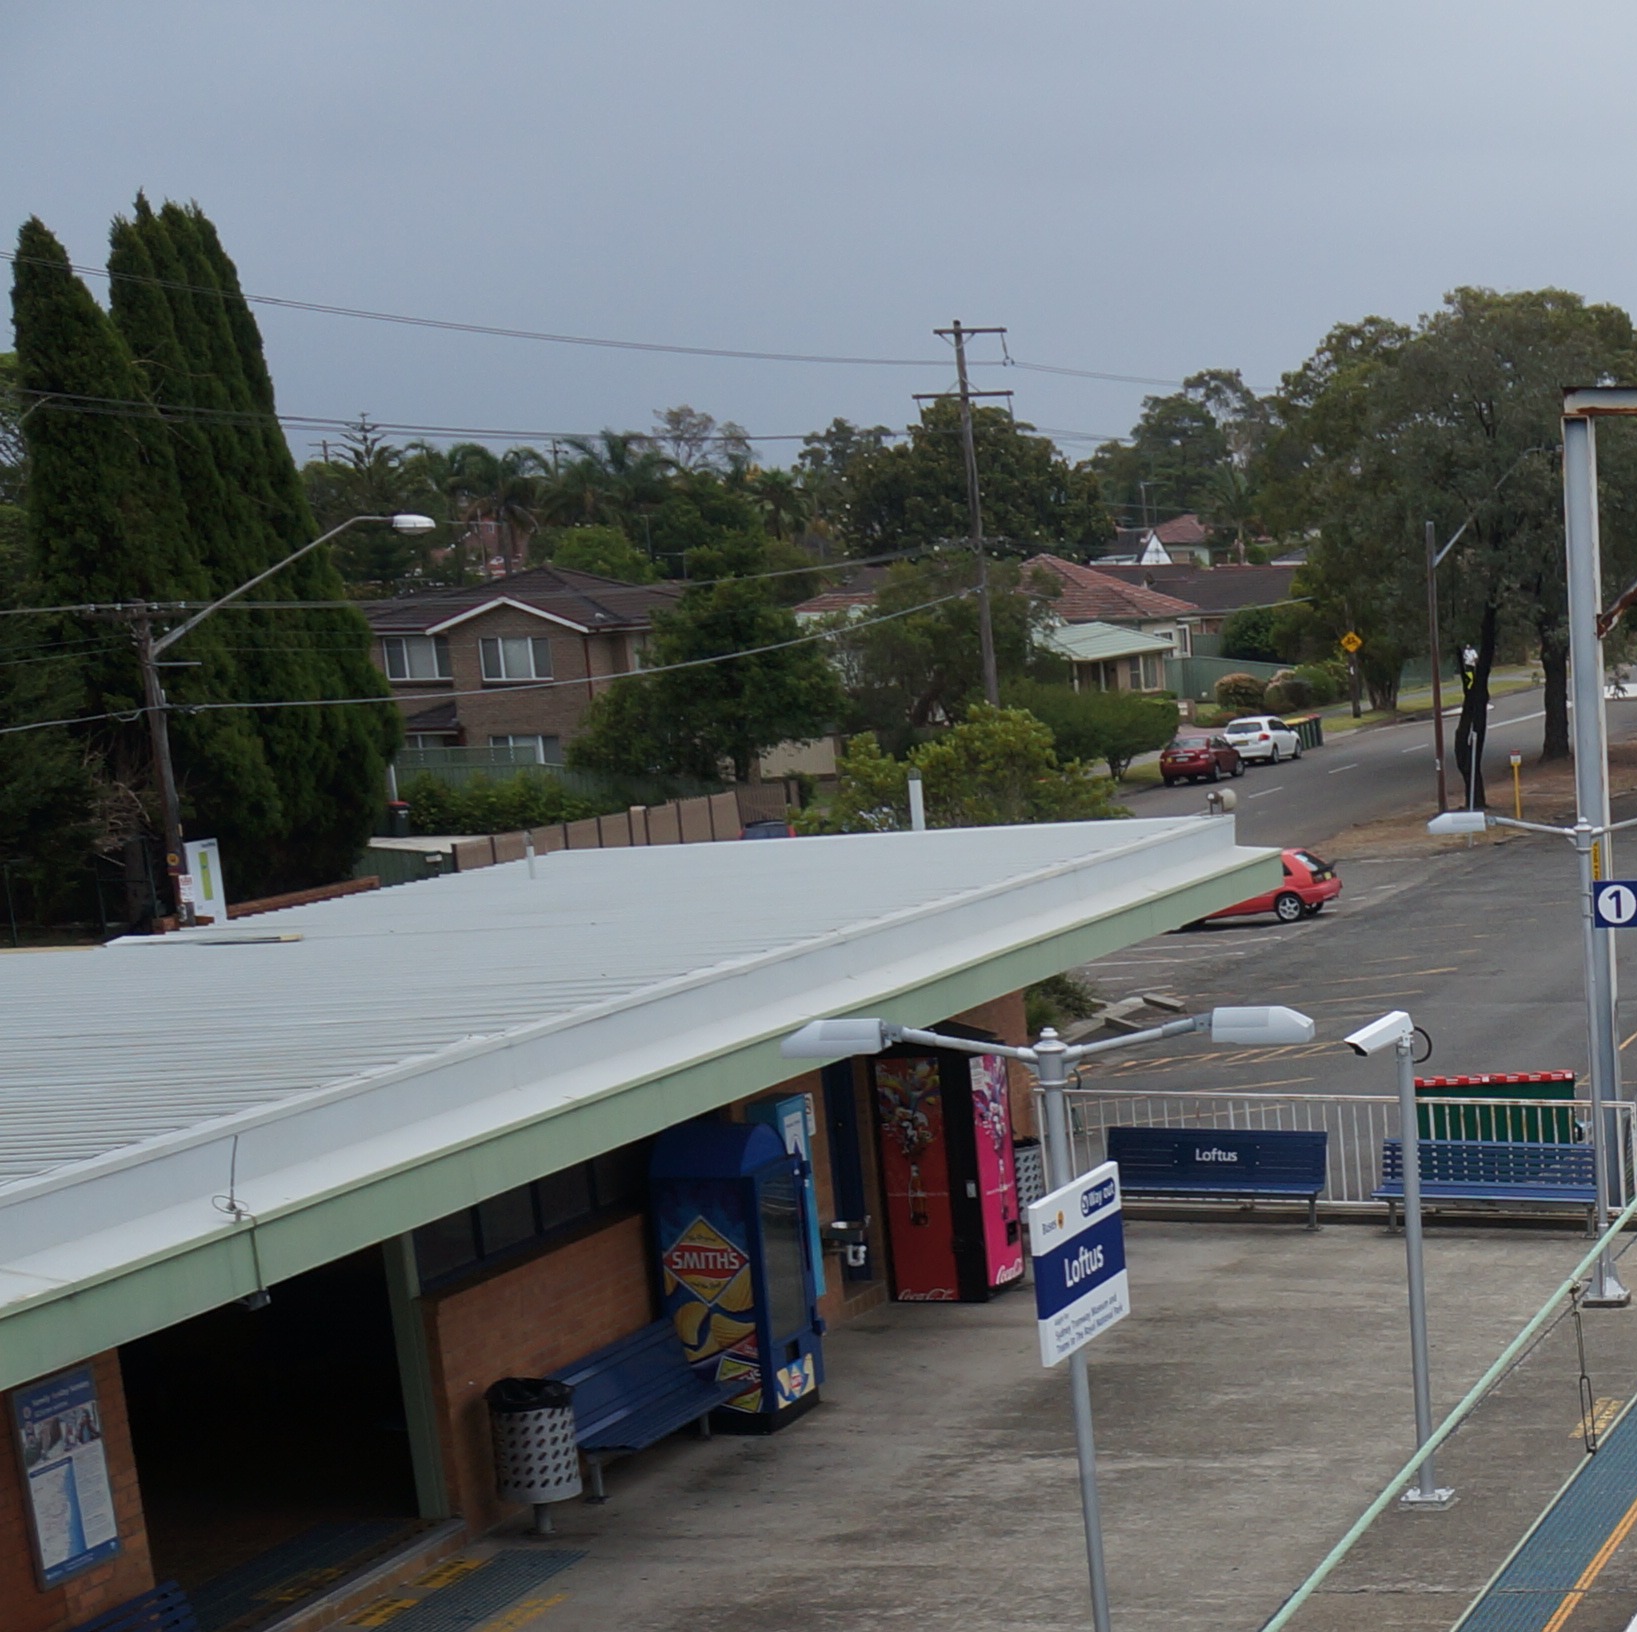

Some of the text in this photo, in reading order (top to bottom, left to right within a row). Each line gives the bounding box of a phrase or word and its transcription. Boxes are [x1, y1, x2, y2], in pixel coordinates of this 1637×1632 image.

[1607, 889, 1622, 919] 1
[1195, 1148, 1238, 1162] Loftus
[1087, 1182, 1114, 1207] Way out
[1042, 1218, 1057, 1236] Buses
[672, 1248, 740, 1270] SMITH'S
[1064, 1244, 1104, 1288] Loftus
